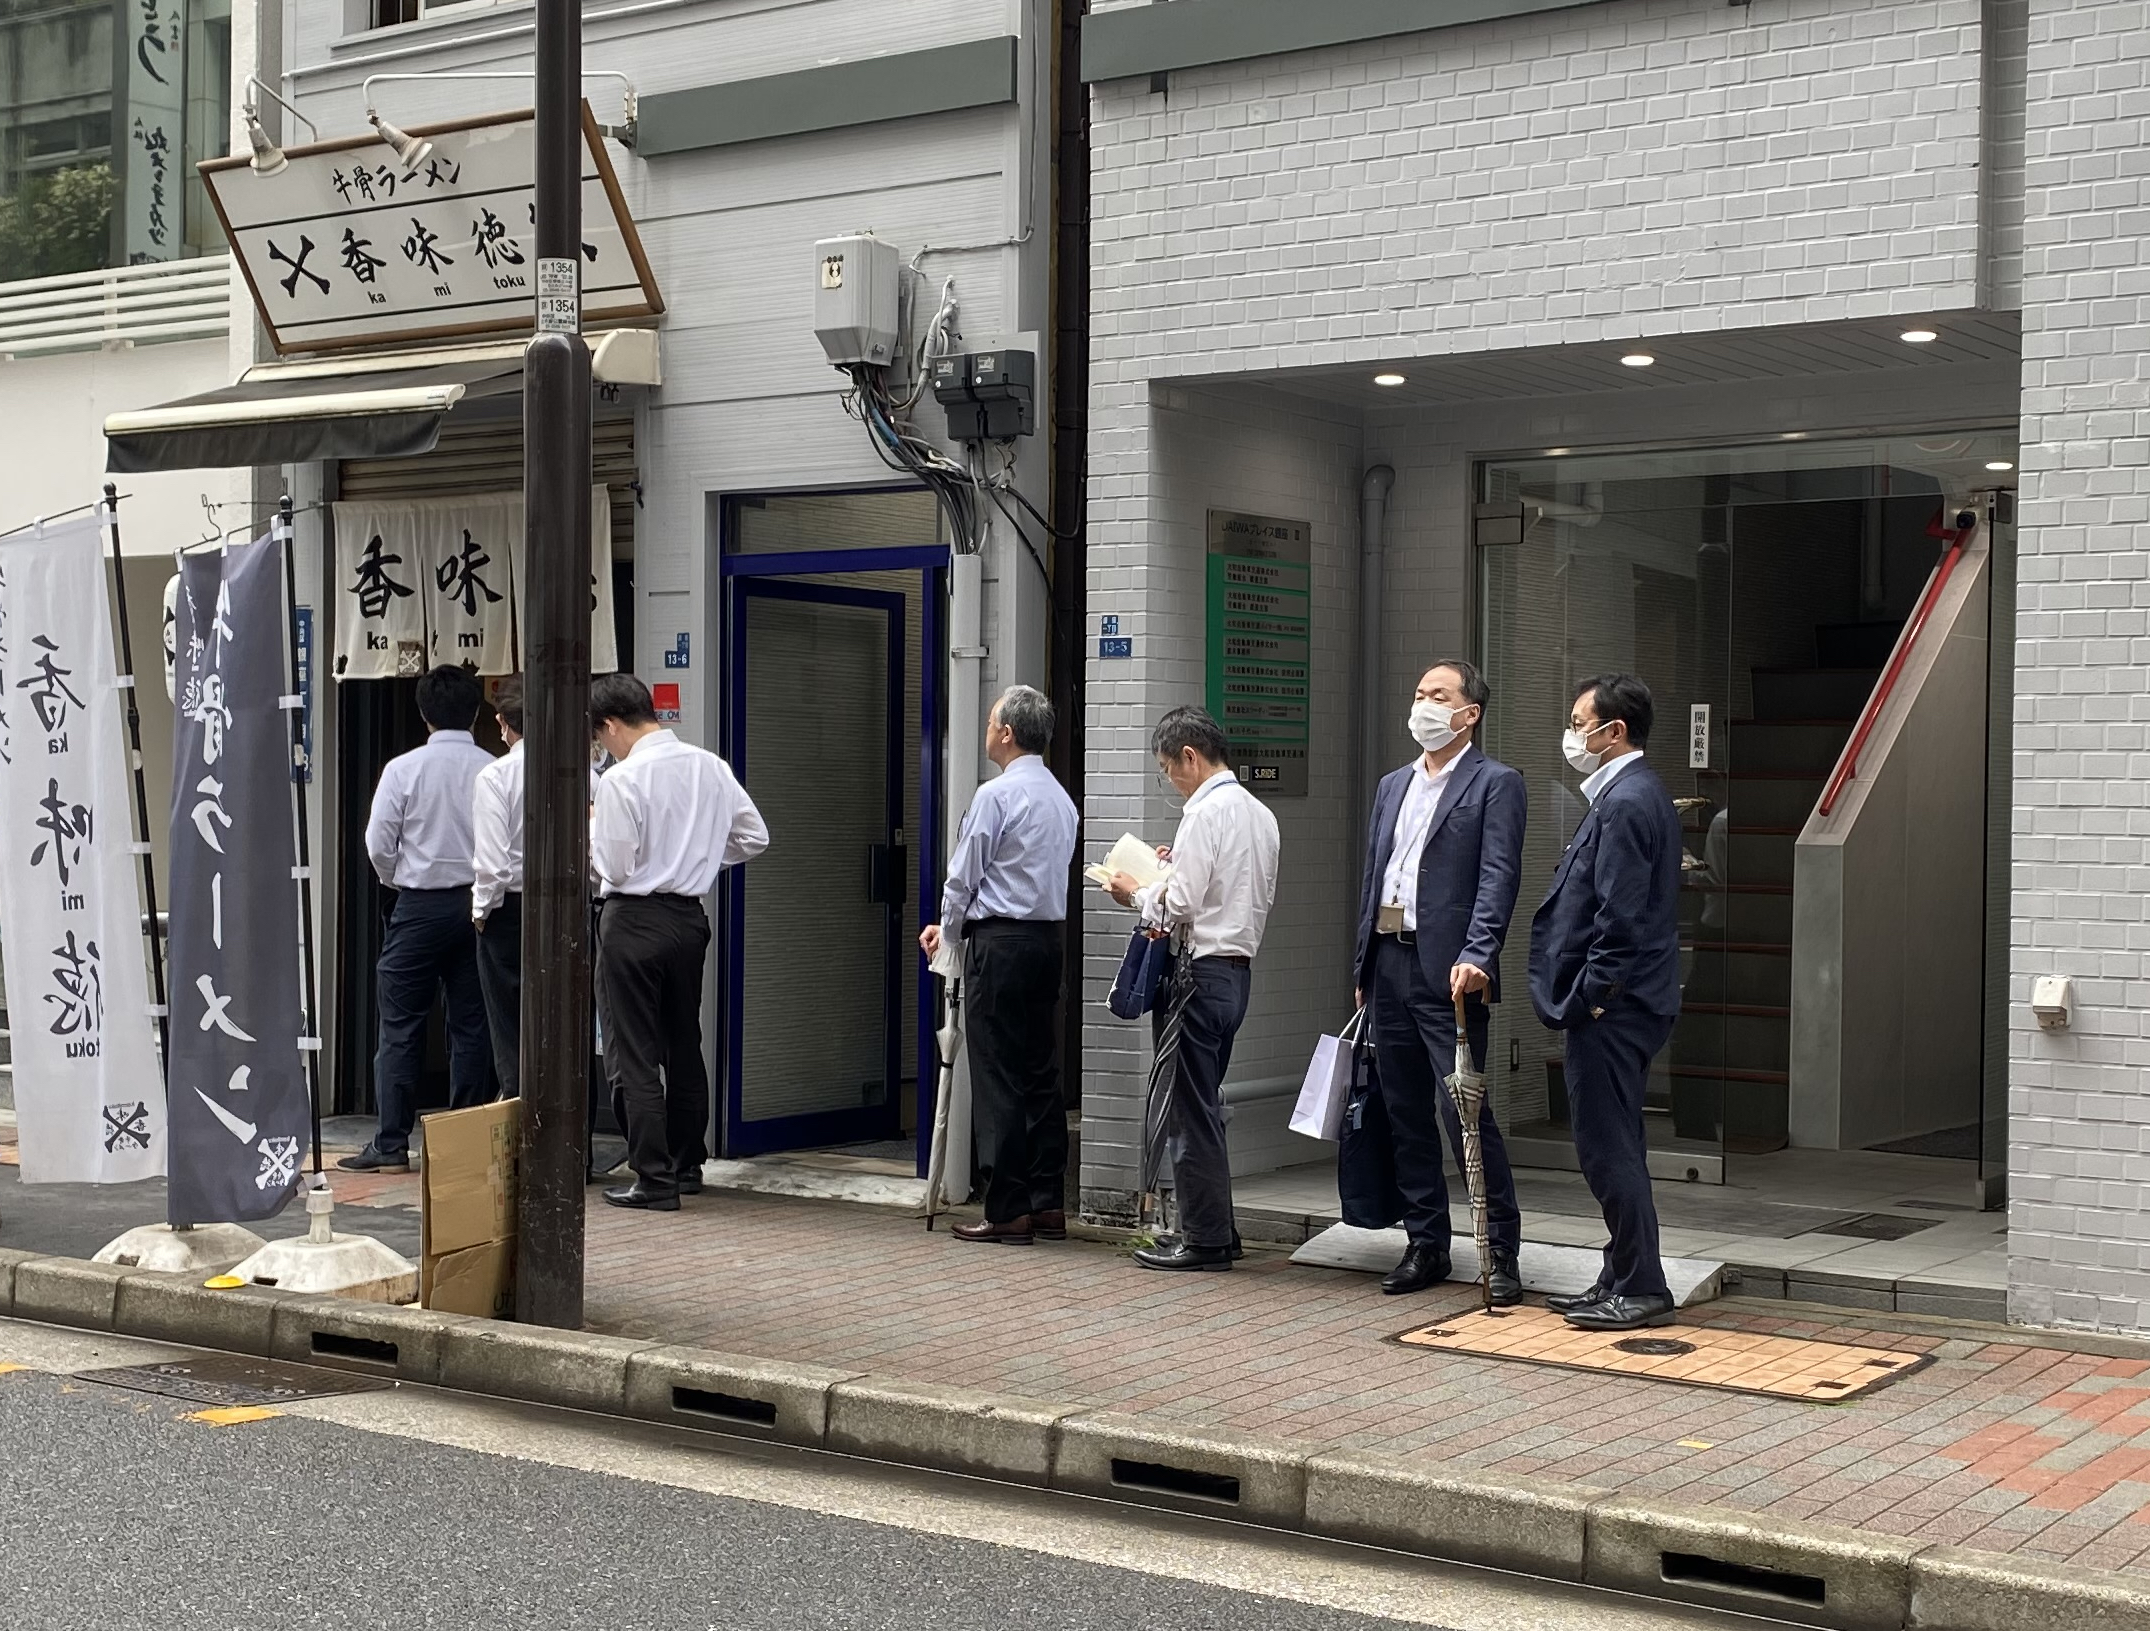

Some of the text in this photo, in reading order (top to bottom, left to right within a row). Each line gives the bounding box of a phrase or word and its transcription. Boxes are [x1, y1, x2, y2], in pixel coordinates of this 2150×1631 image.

[332, 157, 461, 206] 牛骨ラーメン
[340, 207, 525, 284] 香味徳
[550, 261, 573, 274] 1354
[368, 290, 387, 304] ka
[434, 281, 452, 296] mi
[493, 274, 526, 290] toku
[549, 299, 575, 314] 1354
[366, 628, 485, 650] ka mi
[1104, 641, 1128, 653] 13-5
[667, 653, 688, 665] 13-6
[1694, 711, 1706, 763] 開放厳禁
